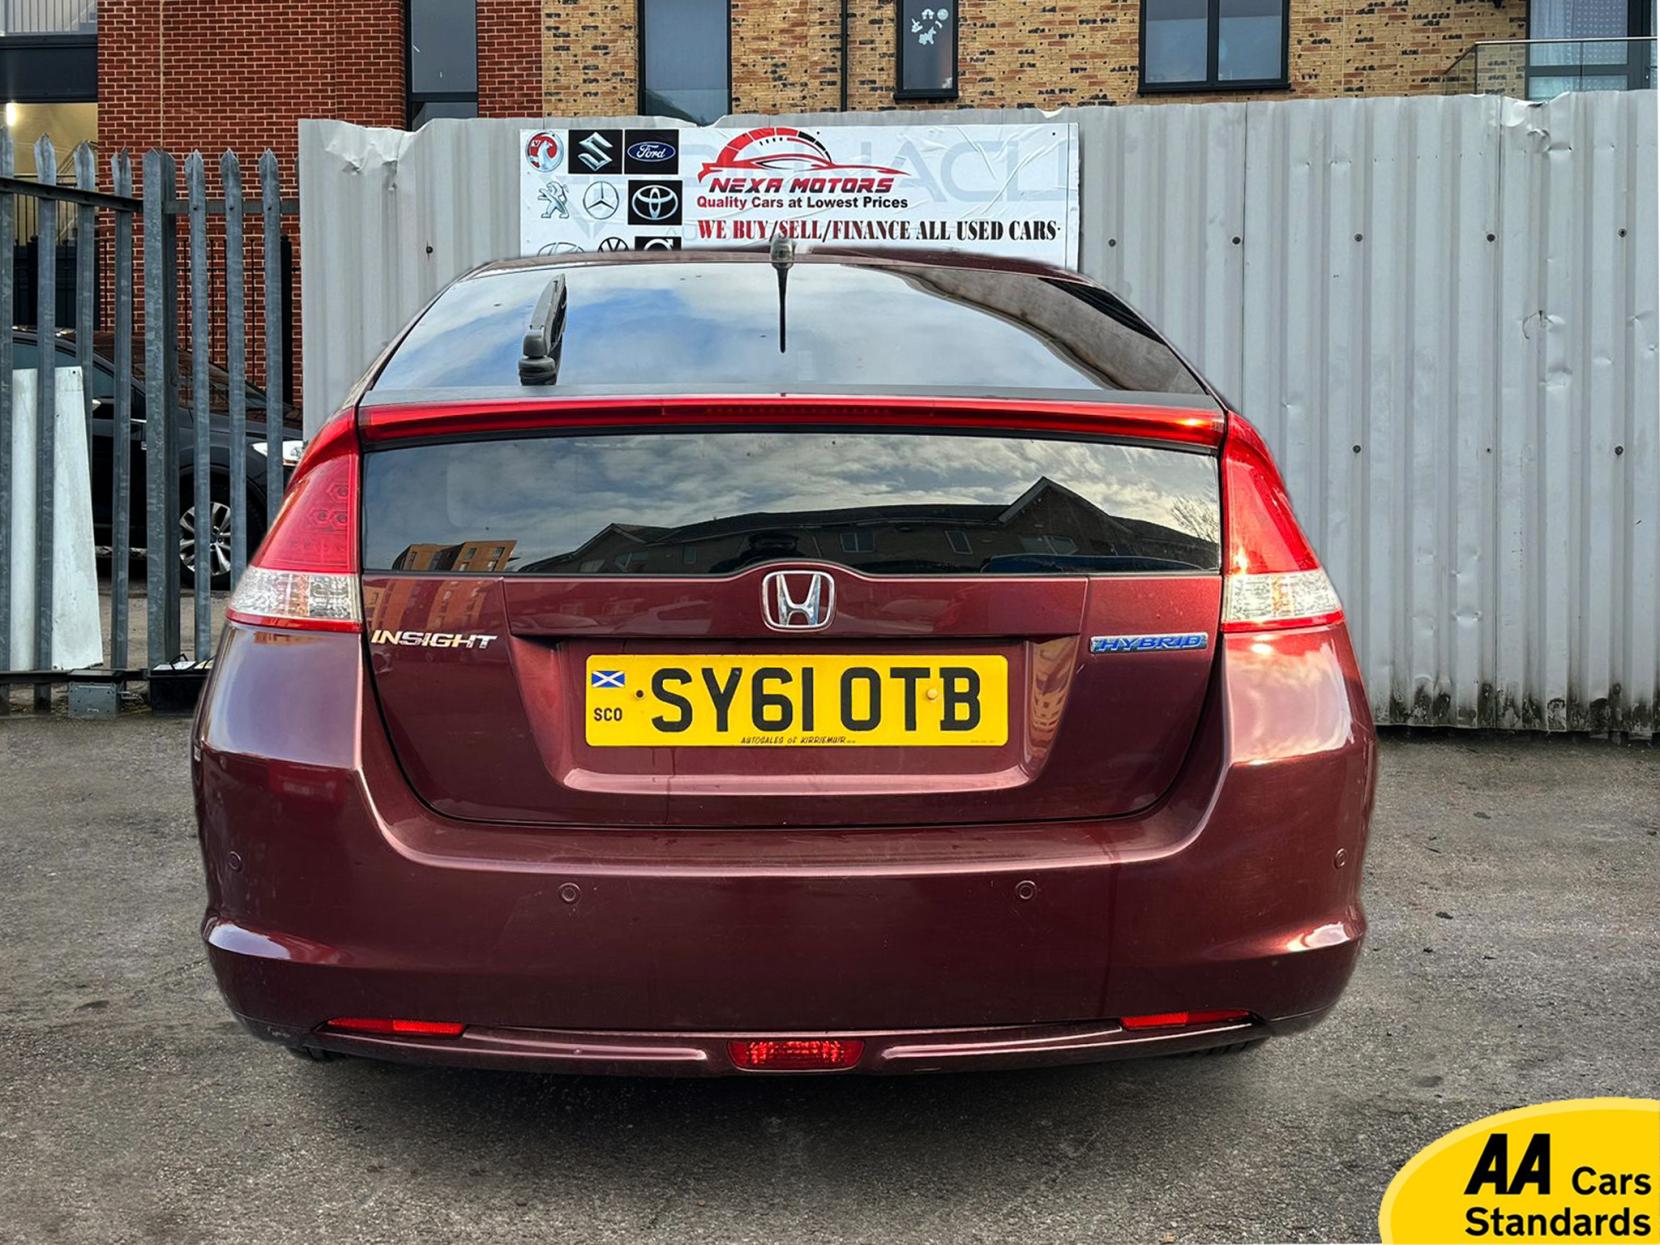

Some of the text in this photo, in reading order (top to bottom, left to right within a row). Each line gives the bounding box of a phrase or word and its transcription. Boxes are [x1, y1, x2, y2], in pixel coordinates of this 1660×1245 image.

[636, 144, 666, 158] Ford
[709, 178, 895, 193] NEXA MOTORS
[697, 196, 908, 211] Quality Cars at Lowest Prices
[697, 220, 726, 240] WE
[916, 220, 951, 240] ALL
[956, 220, 1004, 240] USED
[1008, 219, 1057, 241] CARS
[371, 629, 498, 649] INSIGHT
[1095, 634, 1204, 652] HYBRID
[651, 666, 982, 733] SY61 OTB
[593, 707, 624, 722] SCO
